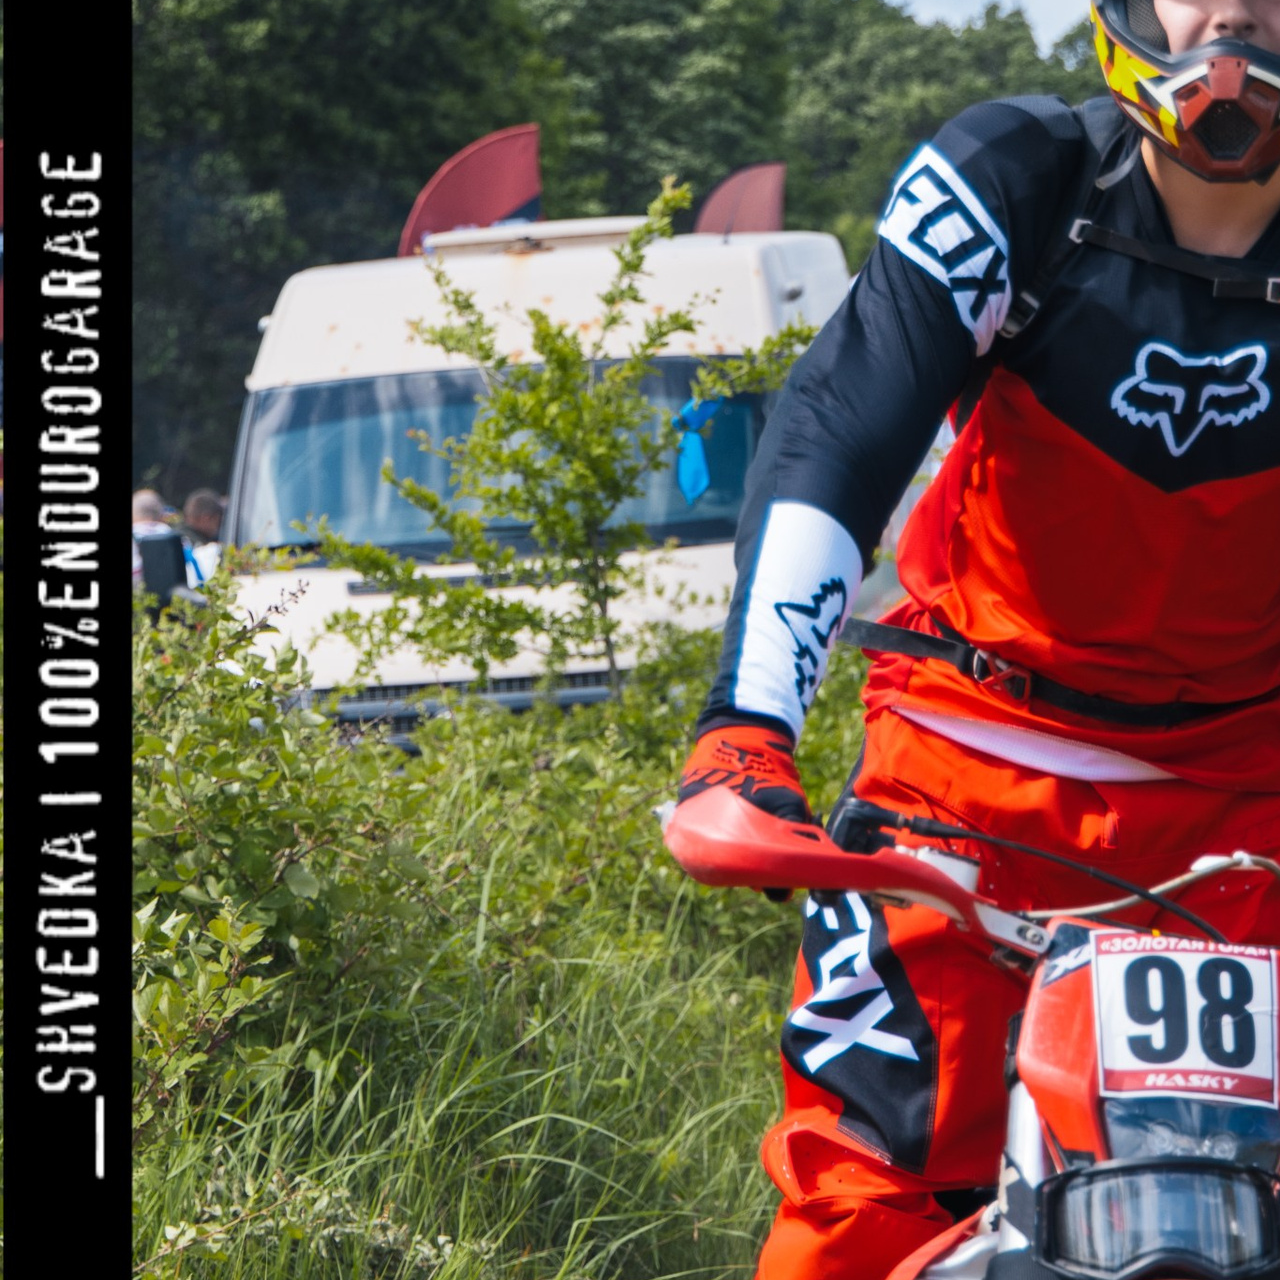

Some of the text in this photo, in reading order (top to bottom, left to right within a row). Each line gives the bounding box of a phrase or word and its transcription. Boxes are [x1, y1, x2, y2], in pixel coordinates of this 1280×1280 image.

[884, 163, 1008, 325] FOX
[1123, 955, 1257, 1069] 98
[1144, 1072, 1239, 1091] HASKY
